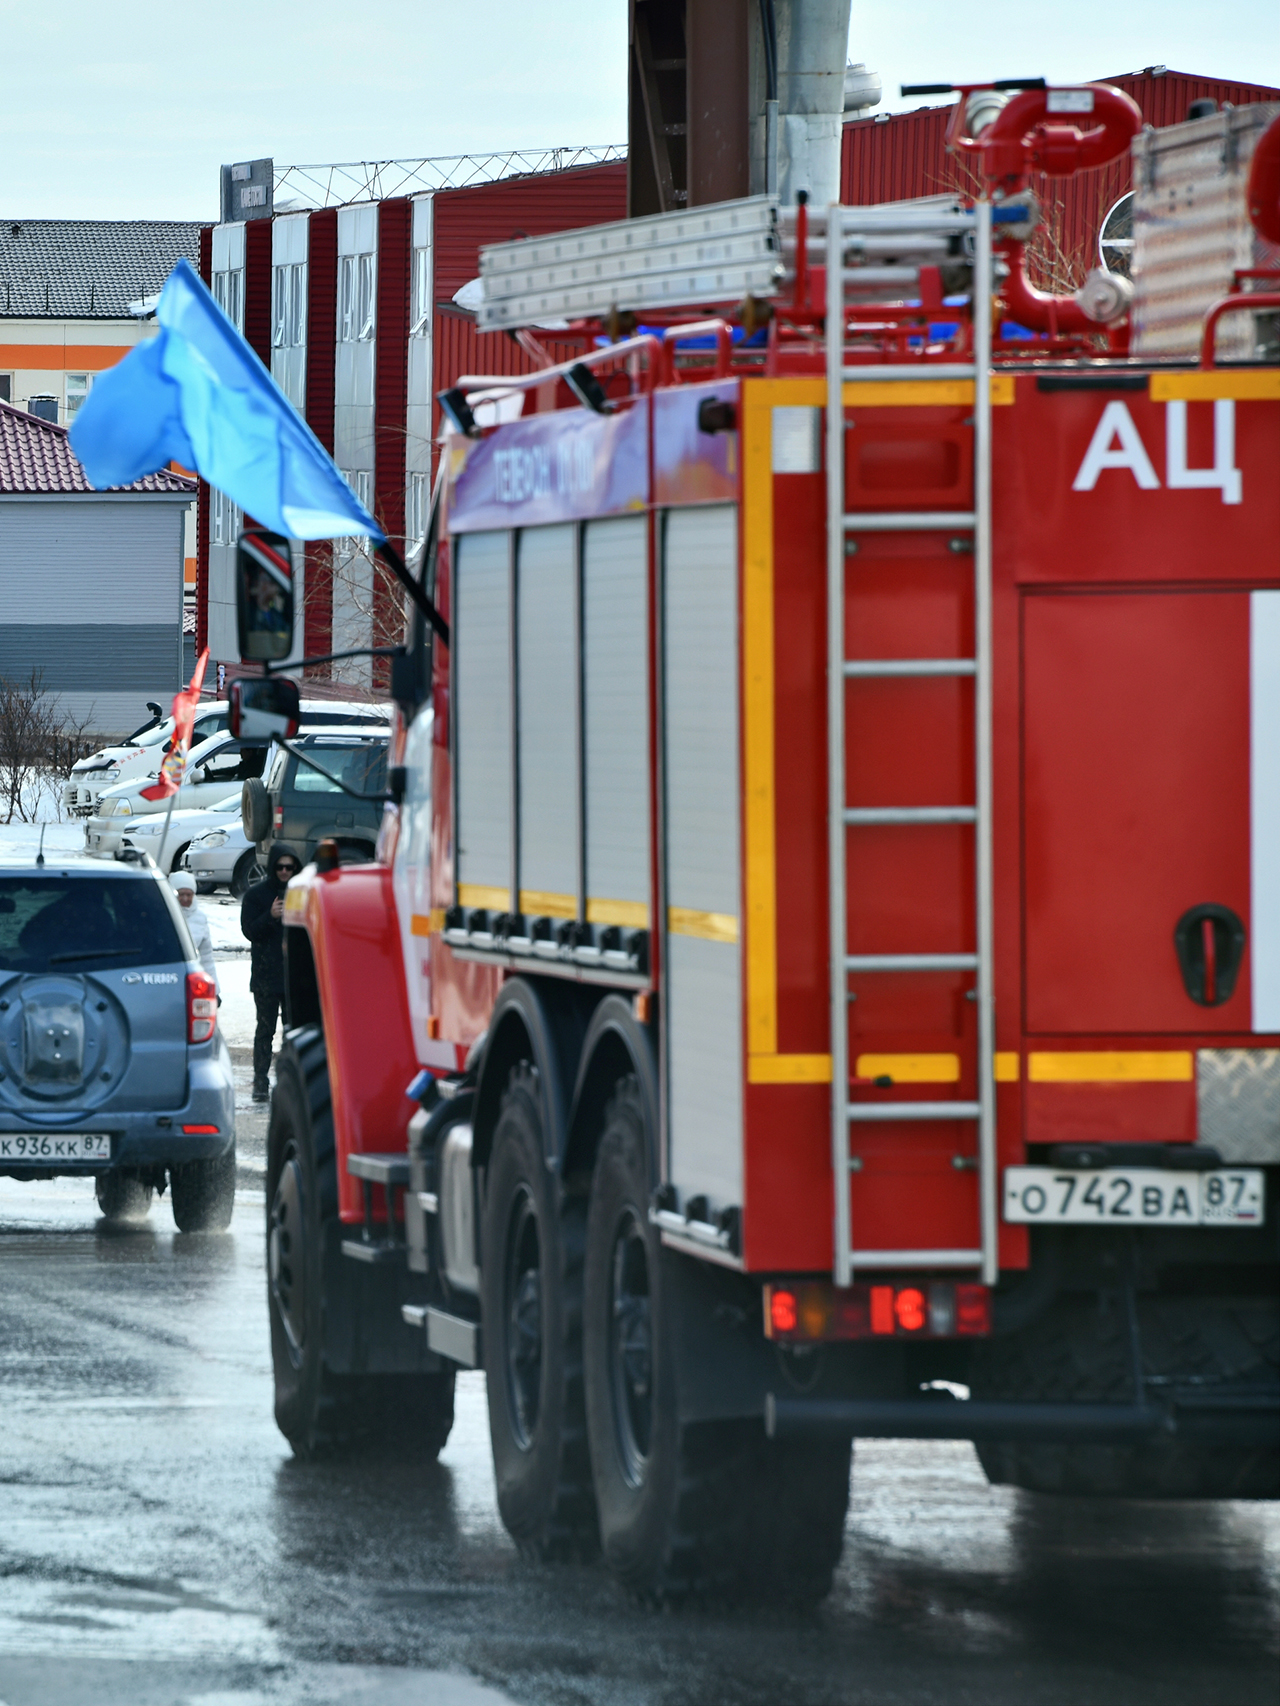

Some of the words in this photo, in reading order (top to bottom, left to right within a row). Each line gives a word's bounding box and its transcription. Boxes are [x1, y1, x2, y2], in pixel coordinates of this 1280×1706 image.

[1071, 398, 1243, 505] АЦ
[84, 1136, 103, 1150] 87
[1021, 1176, 1192, 1218] О742ВА
[1206, 1176, 1245, 1207] 87
